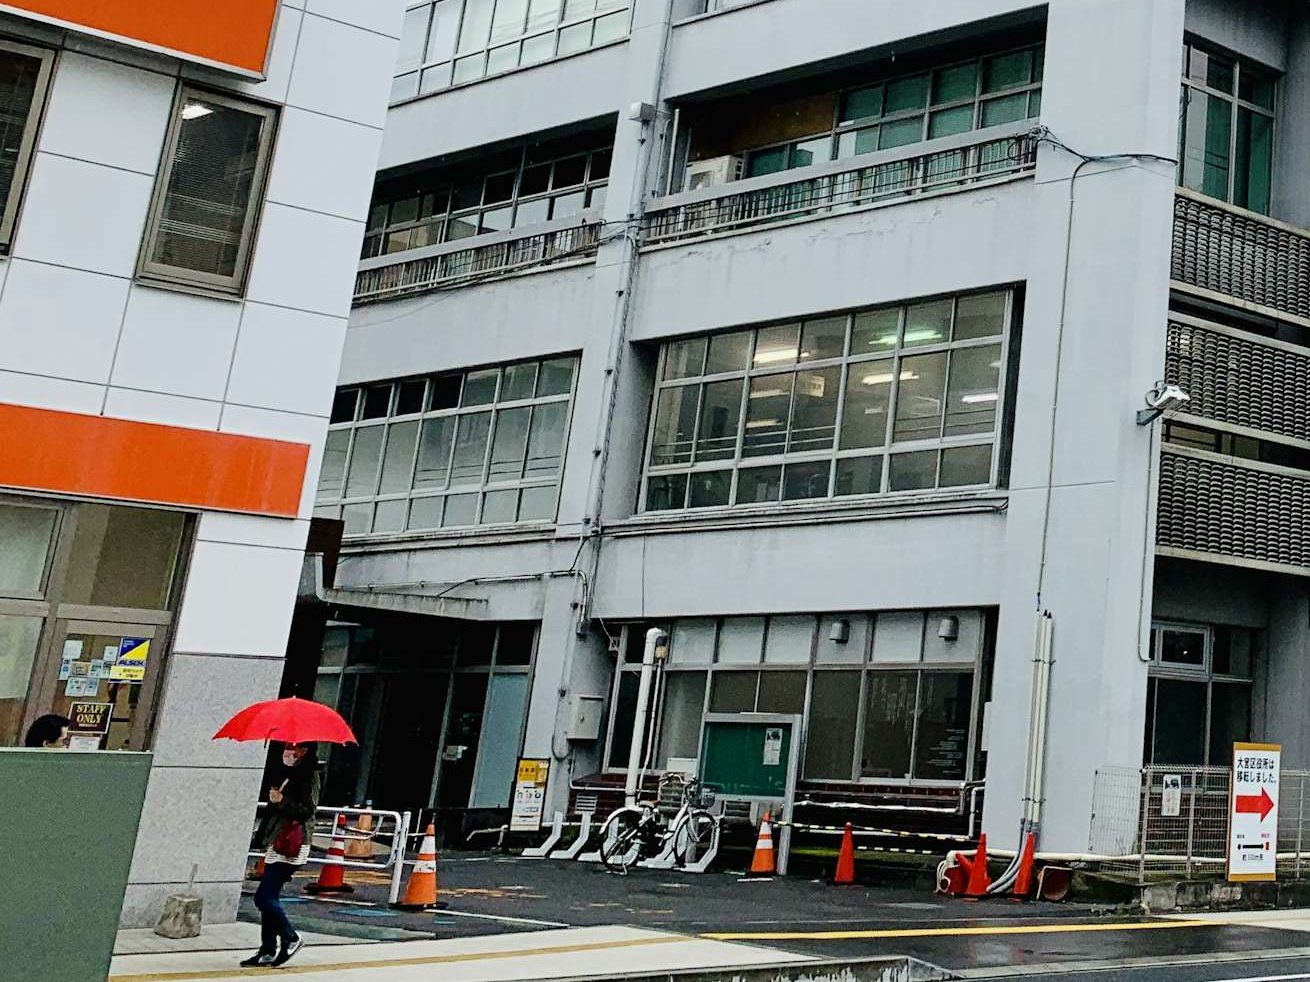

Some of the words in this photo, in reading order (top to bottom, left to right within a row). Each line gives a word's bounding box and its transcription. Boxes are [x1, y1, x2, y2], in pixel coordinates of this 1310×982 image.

[76, 704, 107, 714] STAFF
[76, 714, 103, 724] ONLY
[1237, 756, 1275, 769] 大宮区役所は
[1236, 770, 1277, 784] 移転しました。
